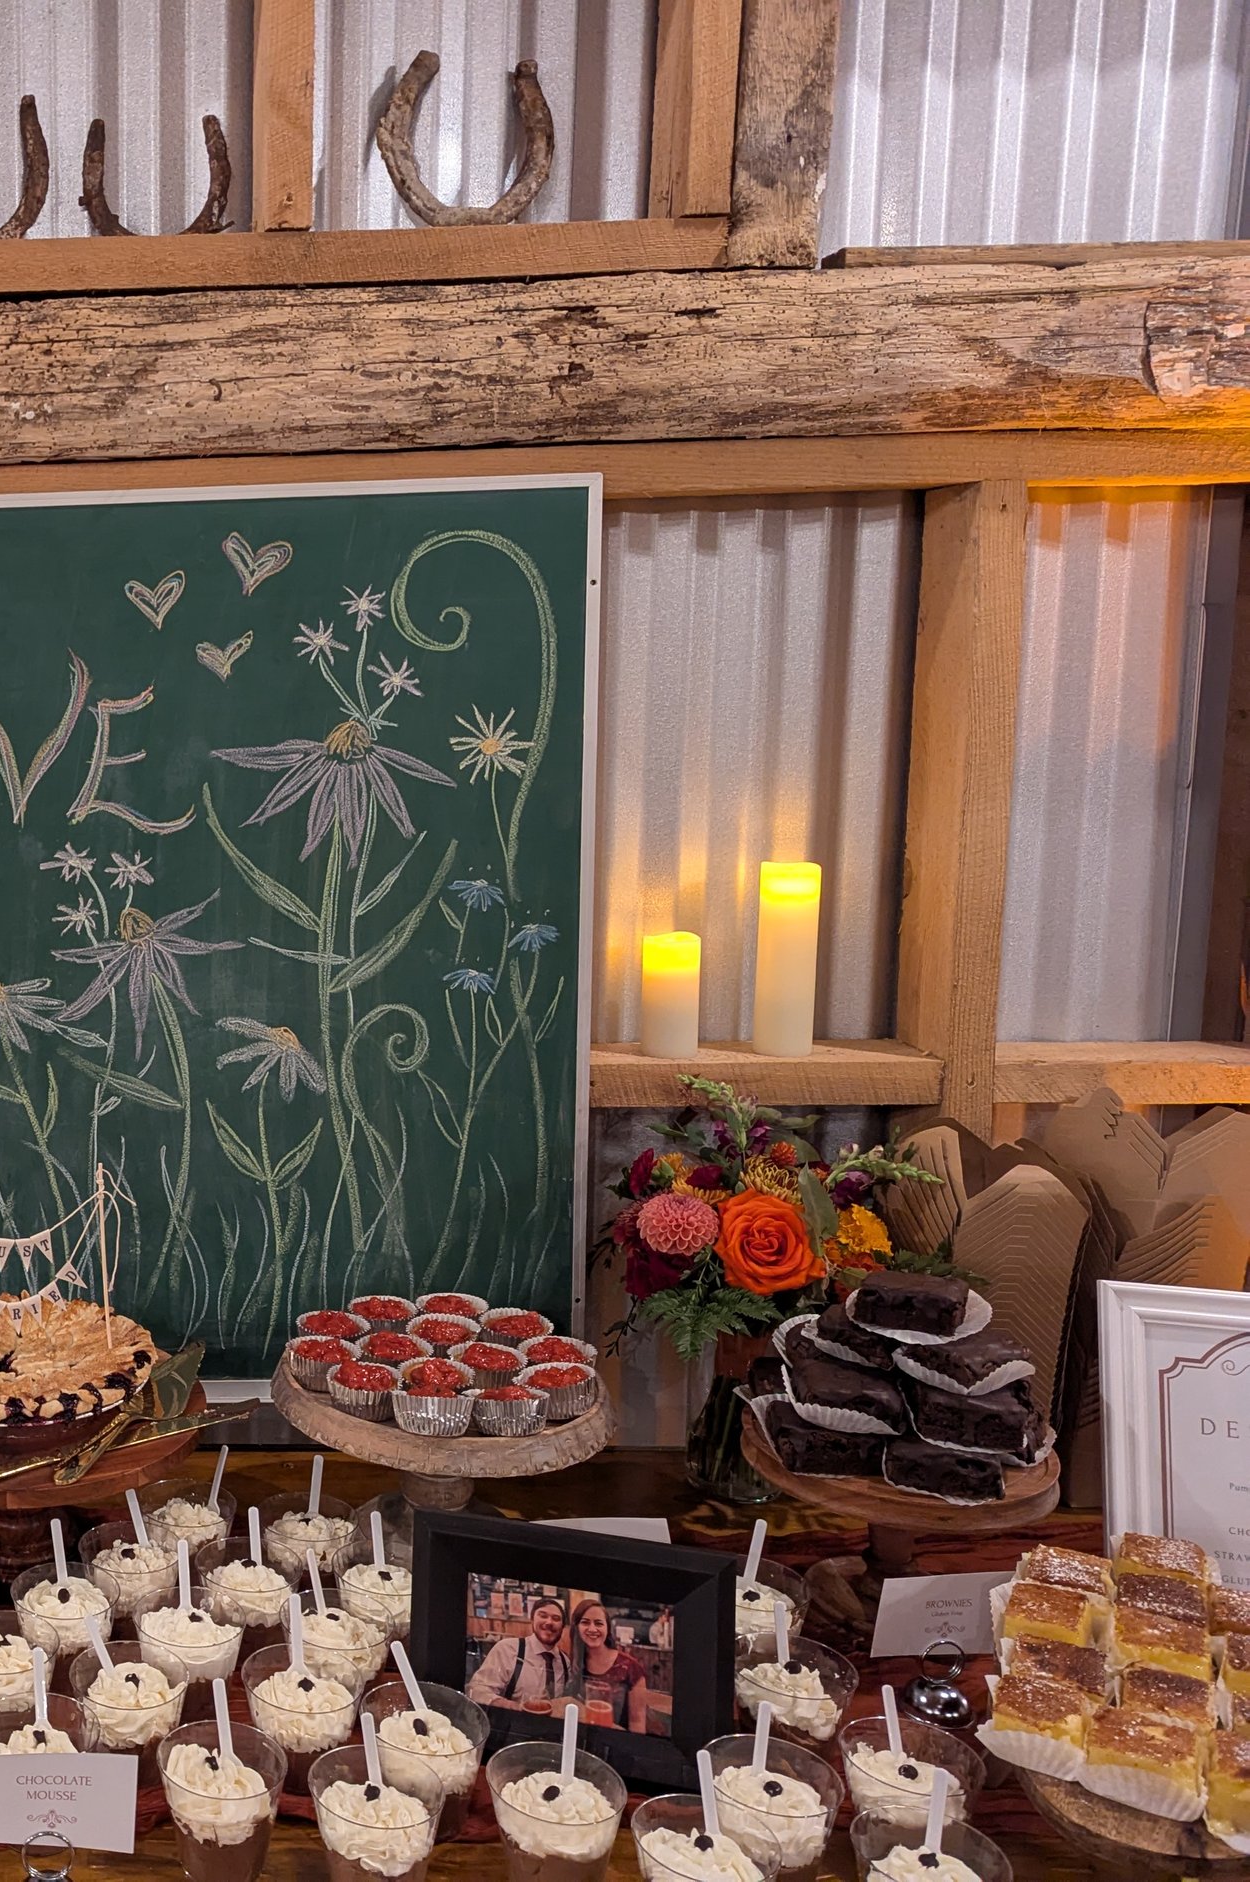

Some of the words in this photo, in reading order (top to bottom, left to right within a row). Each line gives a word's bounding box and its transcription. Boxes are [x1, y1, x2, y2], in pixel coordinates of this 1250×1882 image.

[925, 1598, 973, 1609] BROWNIES
[15, 1775, 93, 1786] CHOCOLATE
[26, 1790, 77, 1801] MOUSSE
